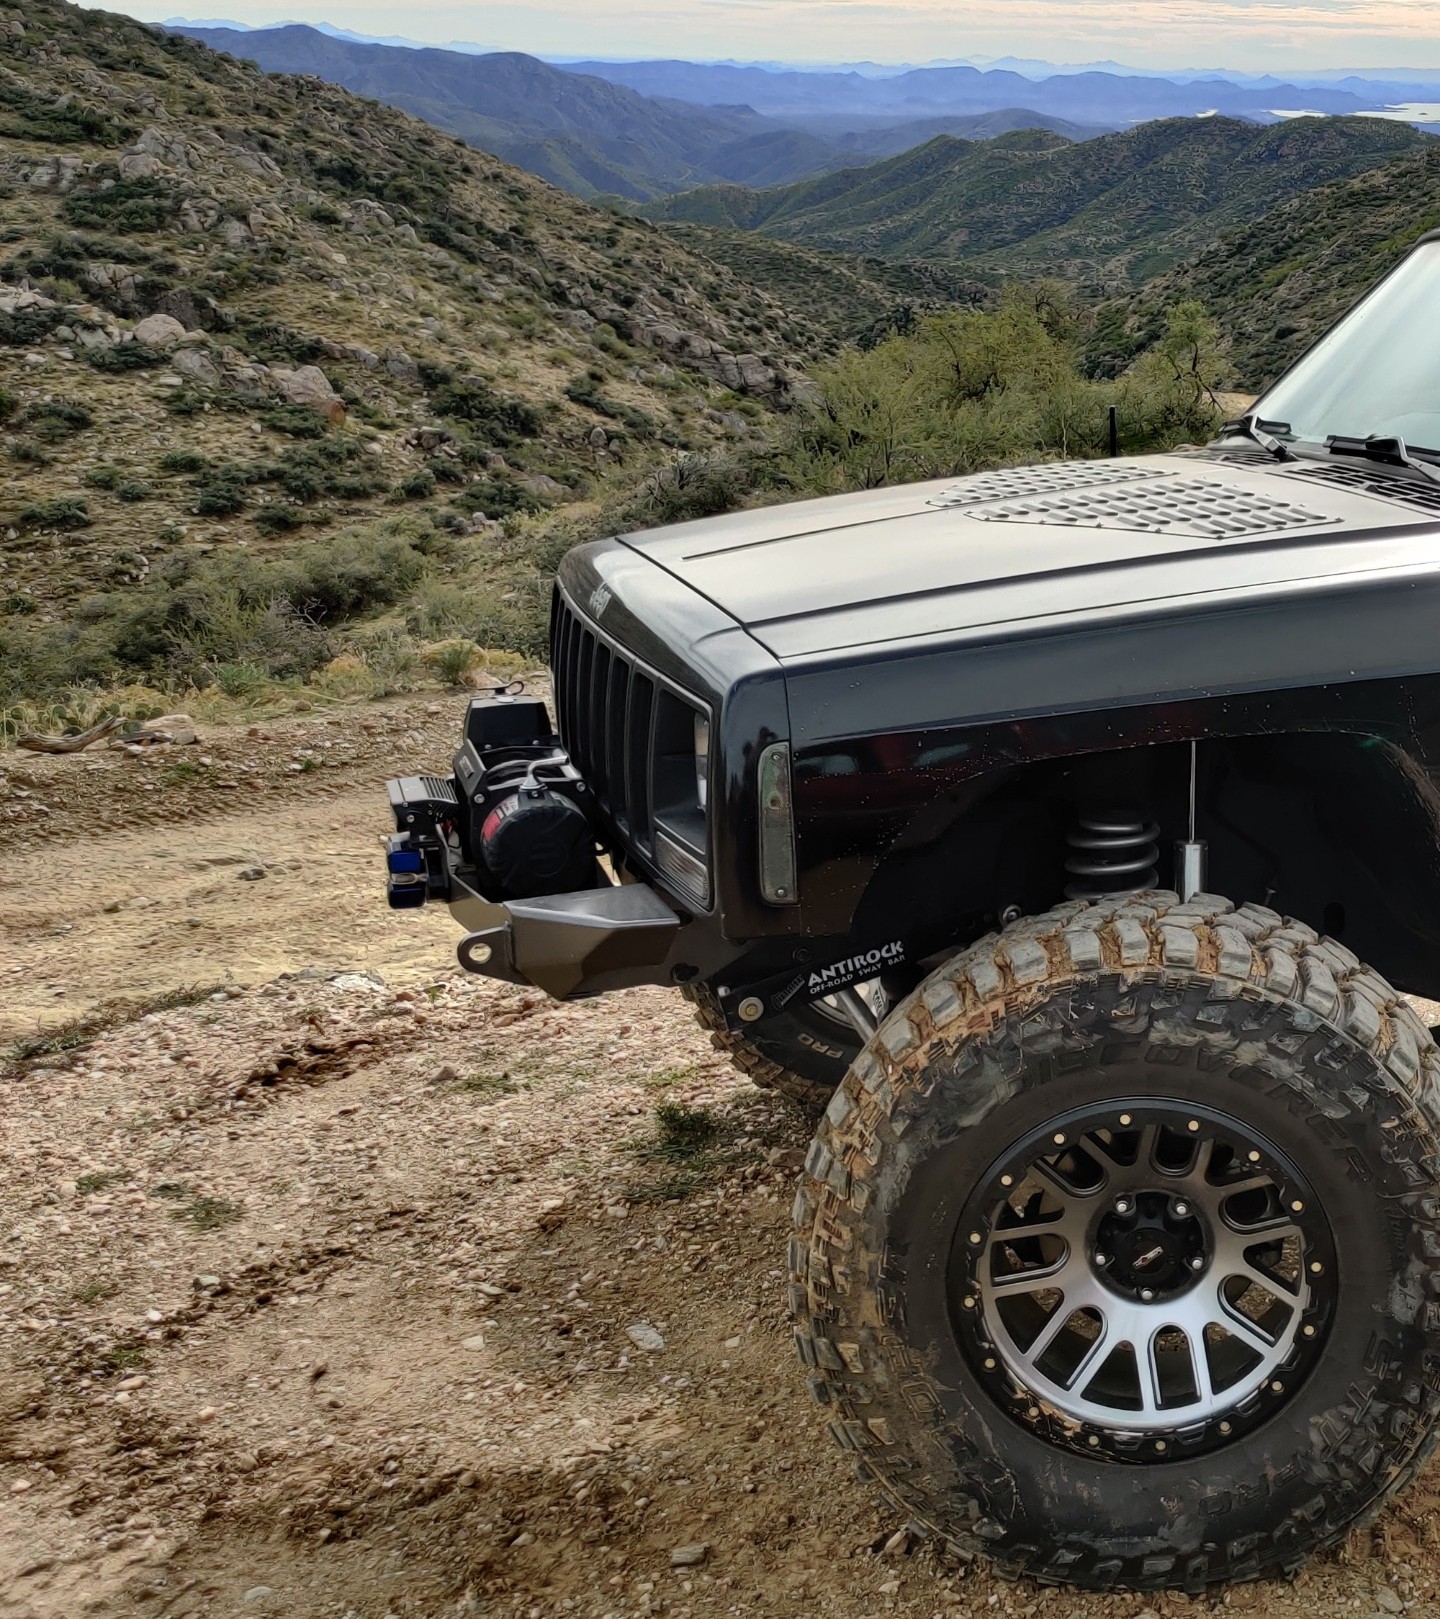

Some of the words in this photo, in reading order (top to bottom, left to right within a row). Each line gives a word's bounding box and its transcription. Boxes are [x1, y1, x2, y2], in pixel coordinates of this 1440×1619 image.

[808, 940, 905, 987] ANTIROCK
[809, 973, 854, 995] OFF-ROAD
[858, 962, 882, 977] SWAY
[887, 954, 906, 967] BAR
[797, 1033, 845, 1059] PRO
